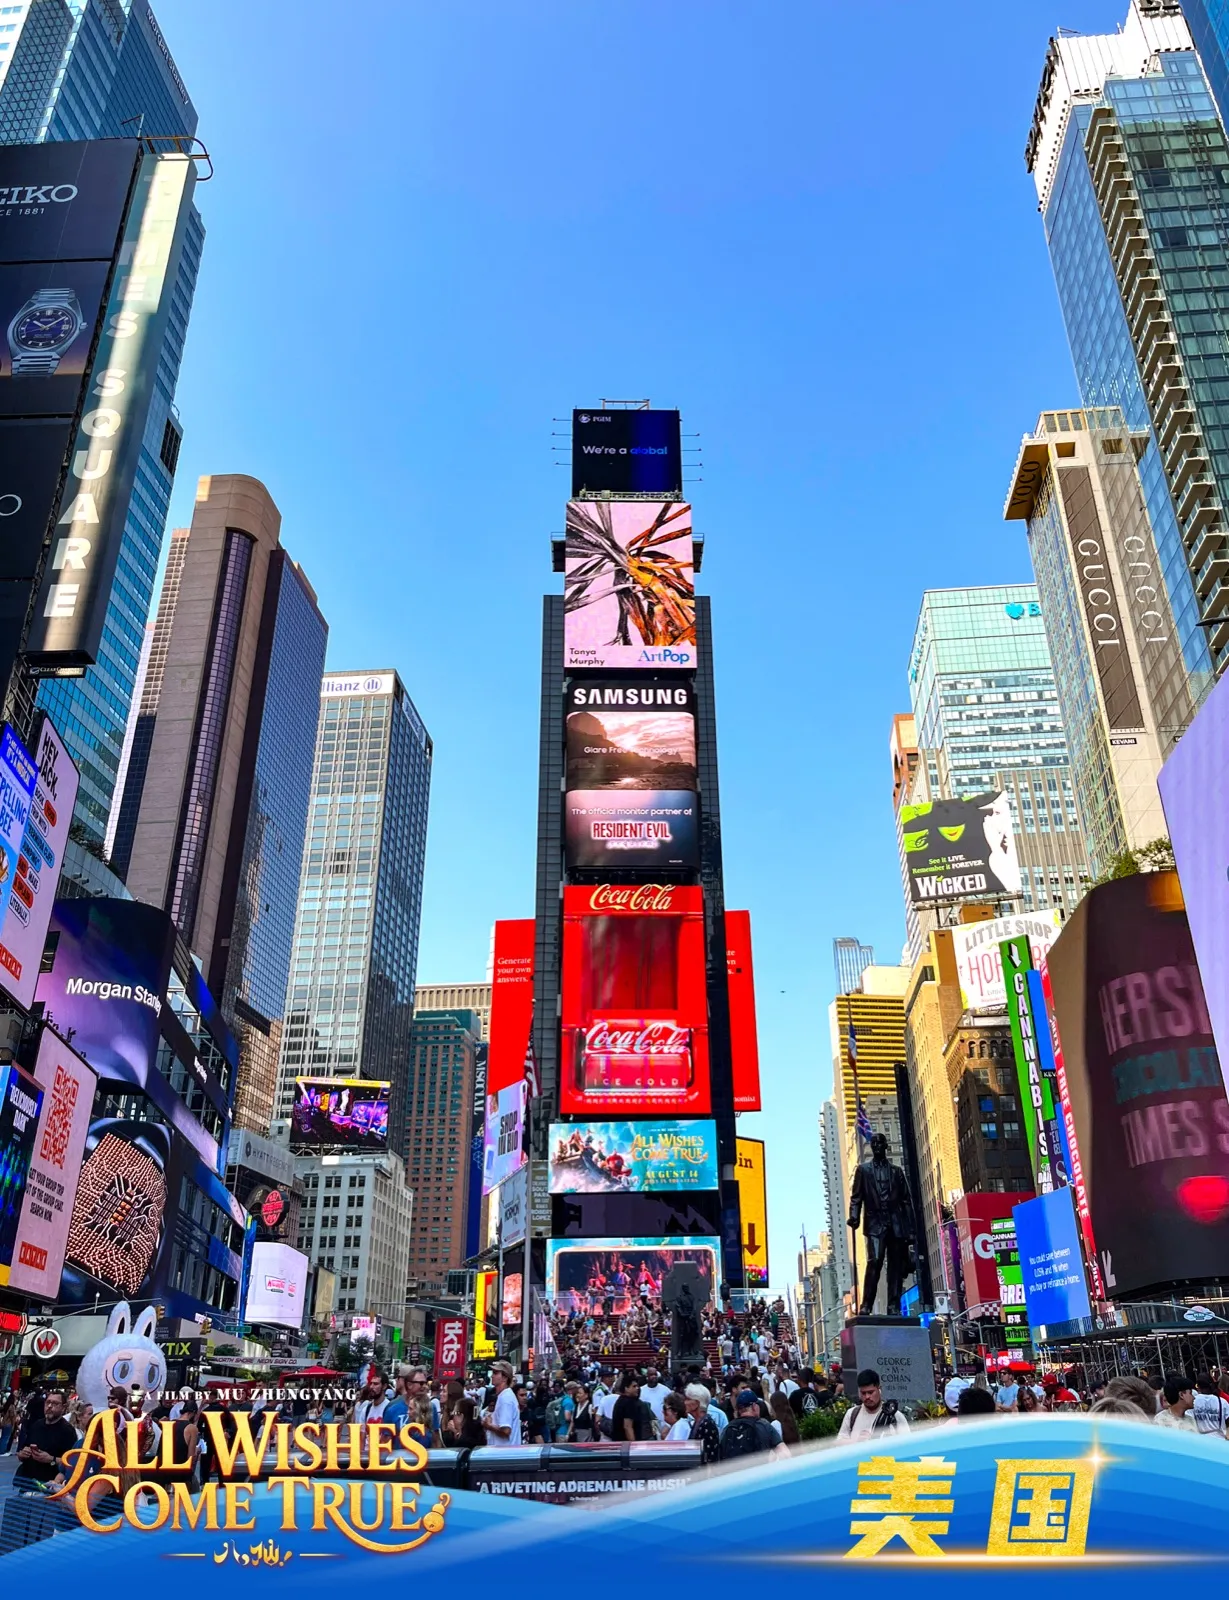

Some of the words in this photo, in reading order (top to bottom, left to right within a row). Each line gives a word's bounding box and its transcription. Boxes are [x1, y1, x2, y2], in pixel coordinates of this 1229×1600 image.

[19, 207, 45, 216] 1881
[582, 445, 616, 455] We're
[43, 369, 127, 617] SQUARE
[1078, 539, 1120, 645] GUCCI
[569, 648, 597, 656] Tanya
[638, 649, 690, 664] ArtPop
[569, 658, 605, 666] Murphy
[573, 688, 688, 705] SAMSUNG
[43, 731, 59, 767] HEY
[583, 746, 607, 754] Glare
[650, 808, 682, 816] partner
[593, 822, 644, 838] RESIDENT
[646, 822, 670, 838] EVIL
[589, 884, 676, 911] Coca-Cola
[965, 920, 1013, 953] LITTLE
[1014, 919, 1053, 940] SHOP
[497, 957, 531, 965] Generate
[497, 967, 514, 976] your
[66, 977, 132, 1000] Morgan
[585, 1022, 689, 1054] Coca-Cola
[1013, 972, 1050, 1157] CANNABIS
[594, 1078, 621, 1086] ICE
[635, 1078, 679, 1086] COLD
[500, 1111, 518, 1135] SHOP
[1121, 1100, 1210, 1168] TIMES
[498, 1135, 506, 1156] IN
[630, 1134, 656, 1151] ALL
[658, 1134, 704, 1147] WISHES
[252, 1149, 270, 1164] HYATT
[632, 1147, 669, 1160] COME
[671, 1147, 708, 1164] TRUE
[738, 1152, 753, 1169] in
[646, 1170, 685, 1178] AUGUST
[442, 1321, 463, 1364] tkts
[876, 1357, 912, 1366] GEORGE
[880, 1374, 912, 1383] COHAN
[491, 1480, 557, 1494] RIVETING
[558, 1479, 646, 1493] ADRENALINE
